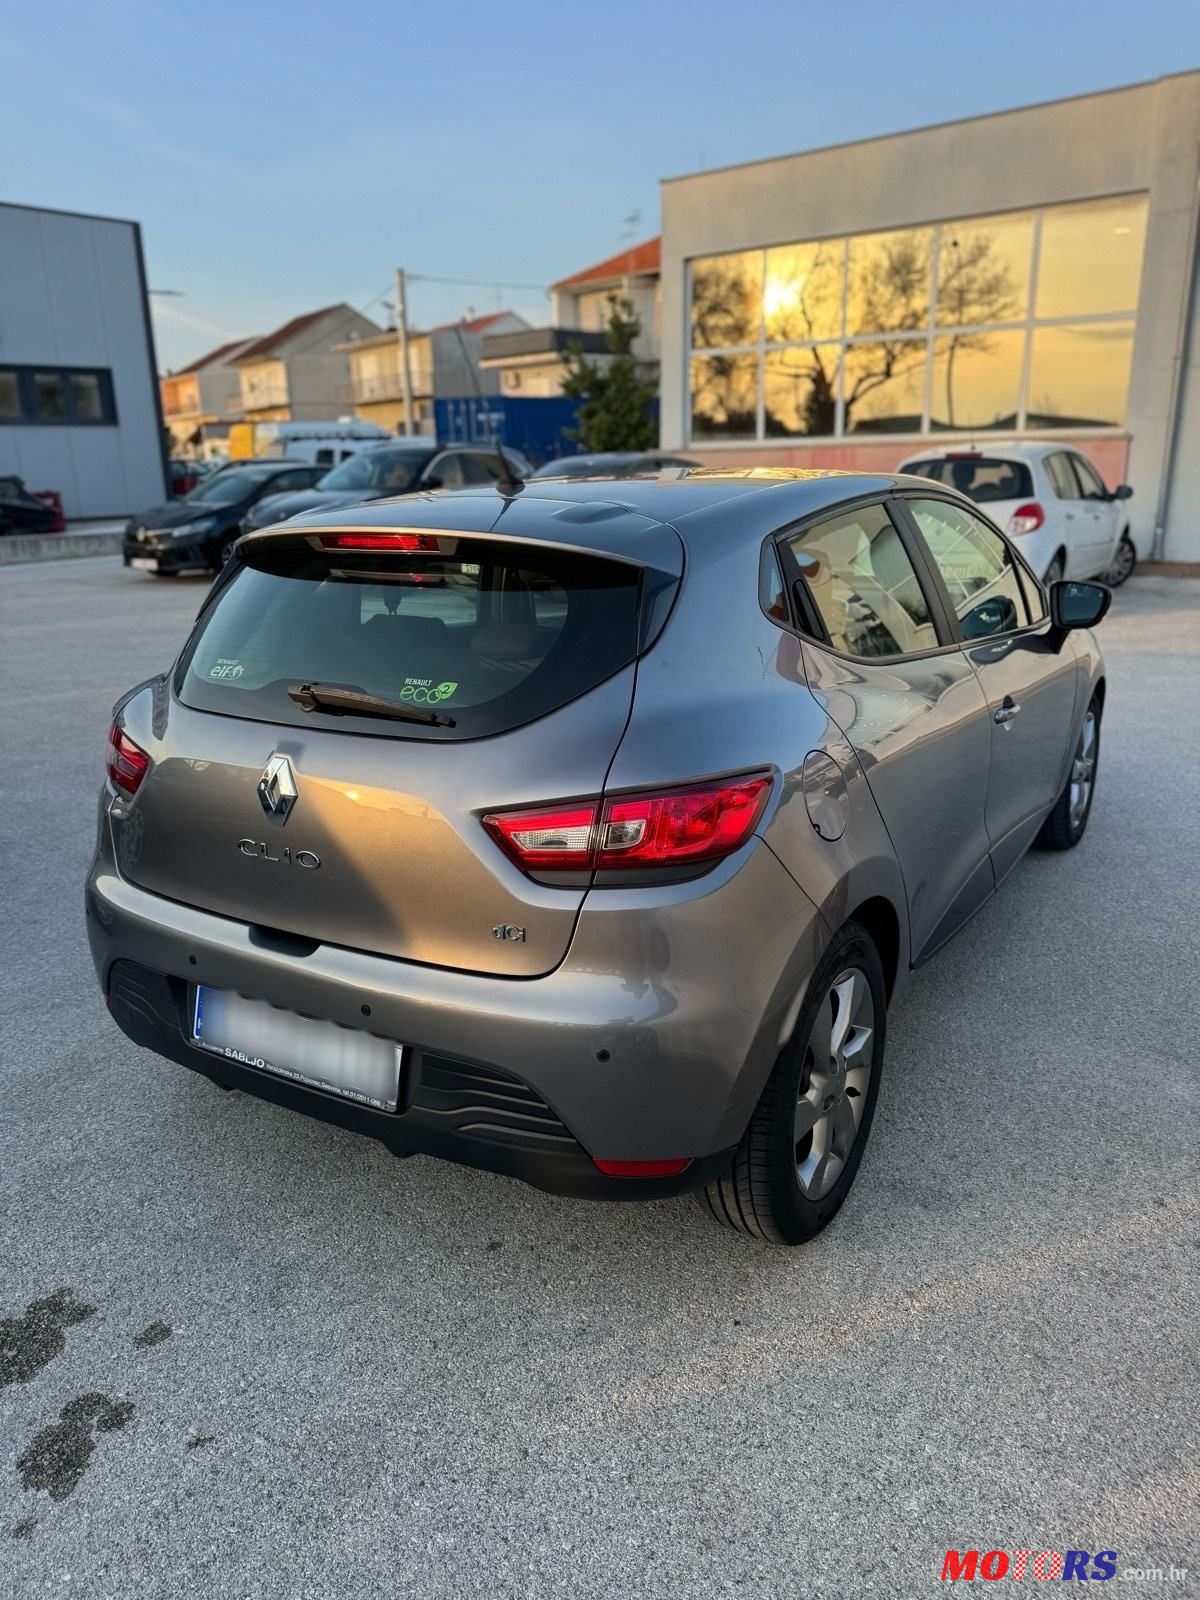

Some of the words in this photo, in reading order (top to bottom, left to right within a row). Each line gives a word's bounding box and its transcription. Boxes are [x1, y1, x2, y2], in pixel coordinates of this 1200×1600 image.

[404, 677, 433, 687] RENAULT
[238, 838, 321, 869] CLIO
[492, 924, 526, 943] dCi
[224, 1047, 265, 1068] SABLJO
